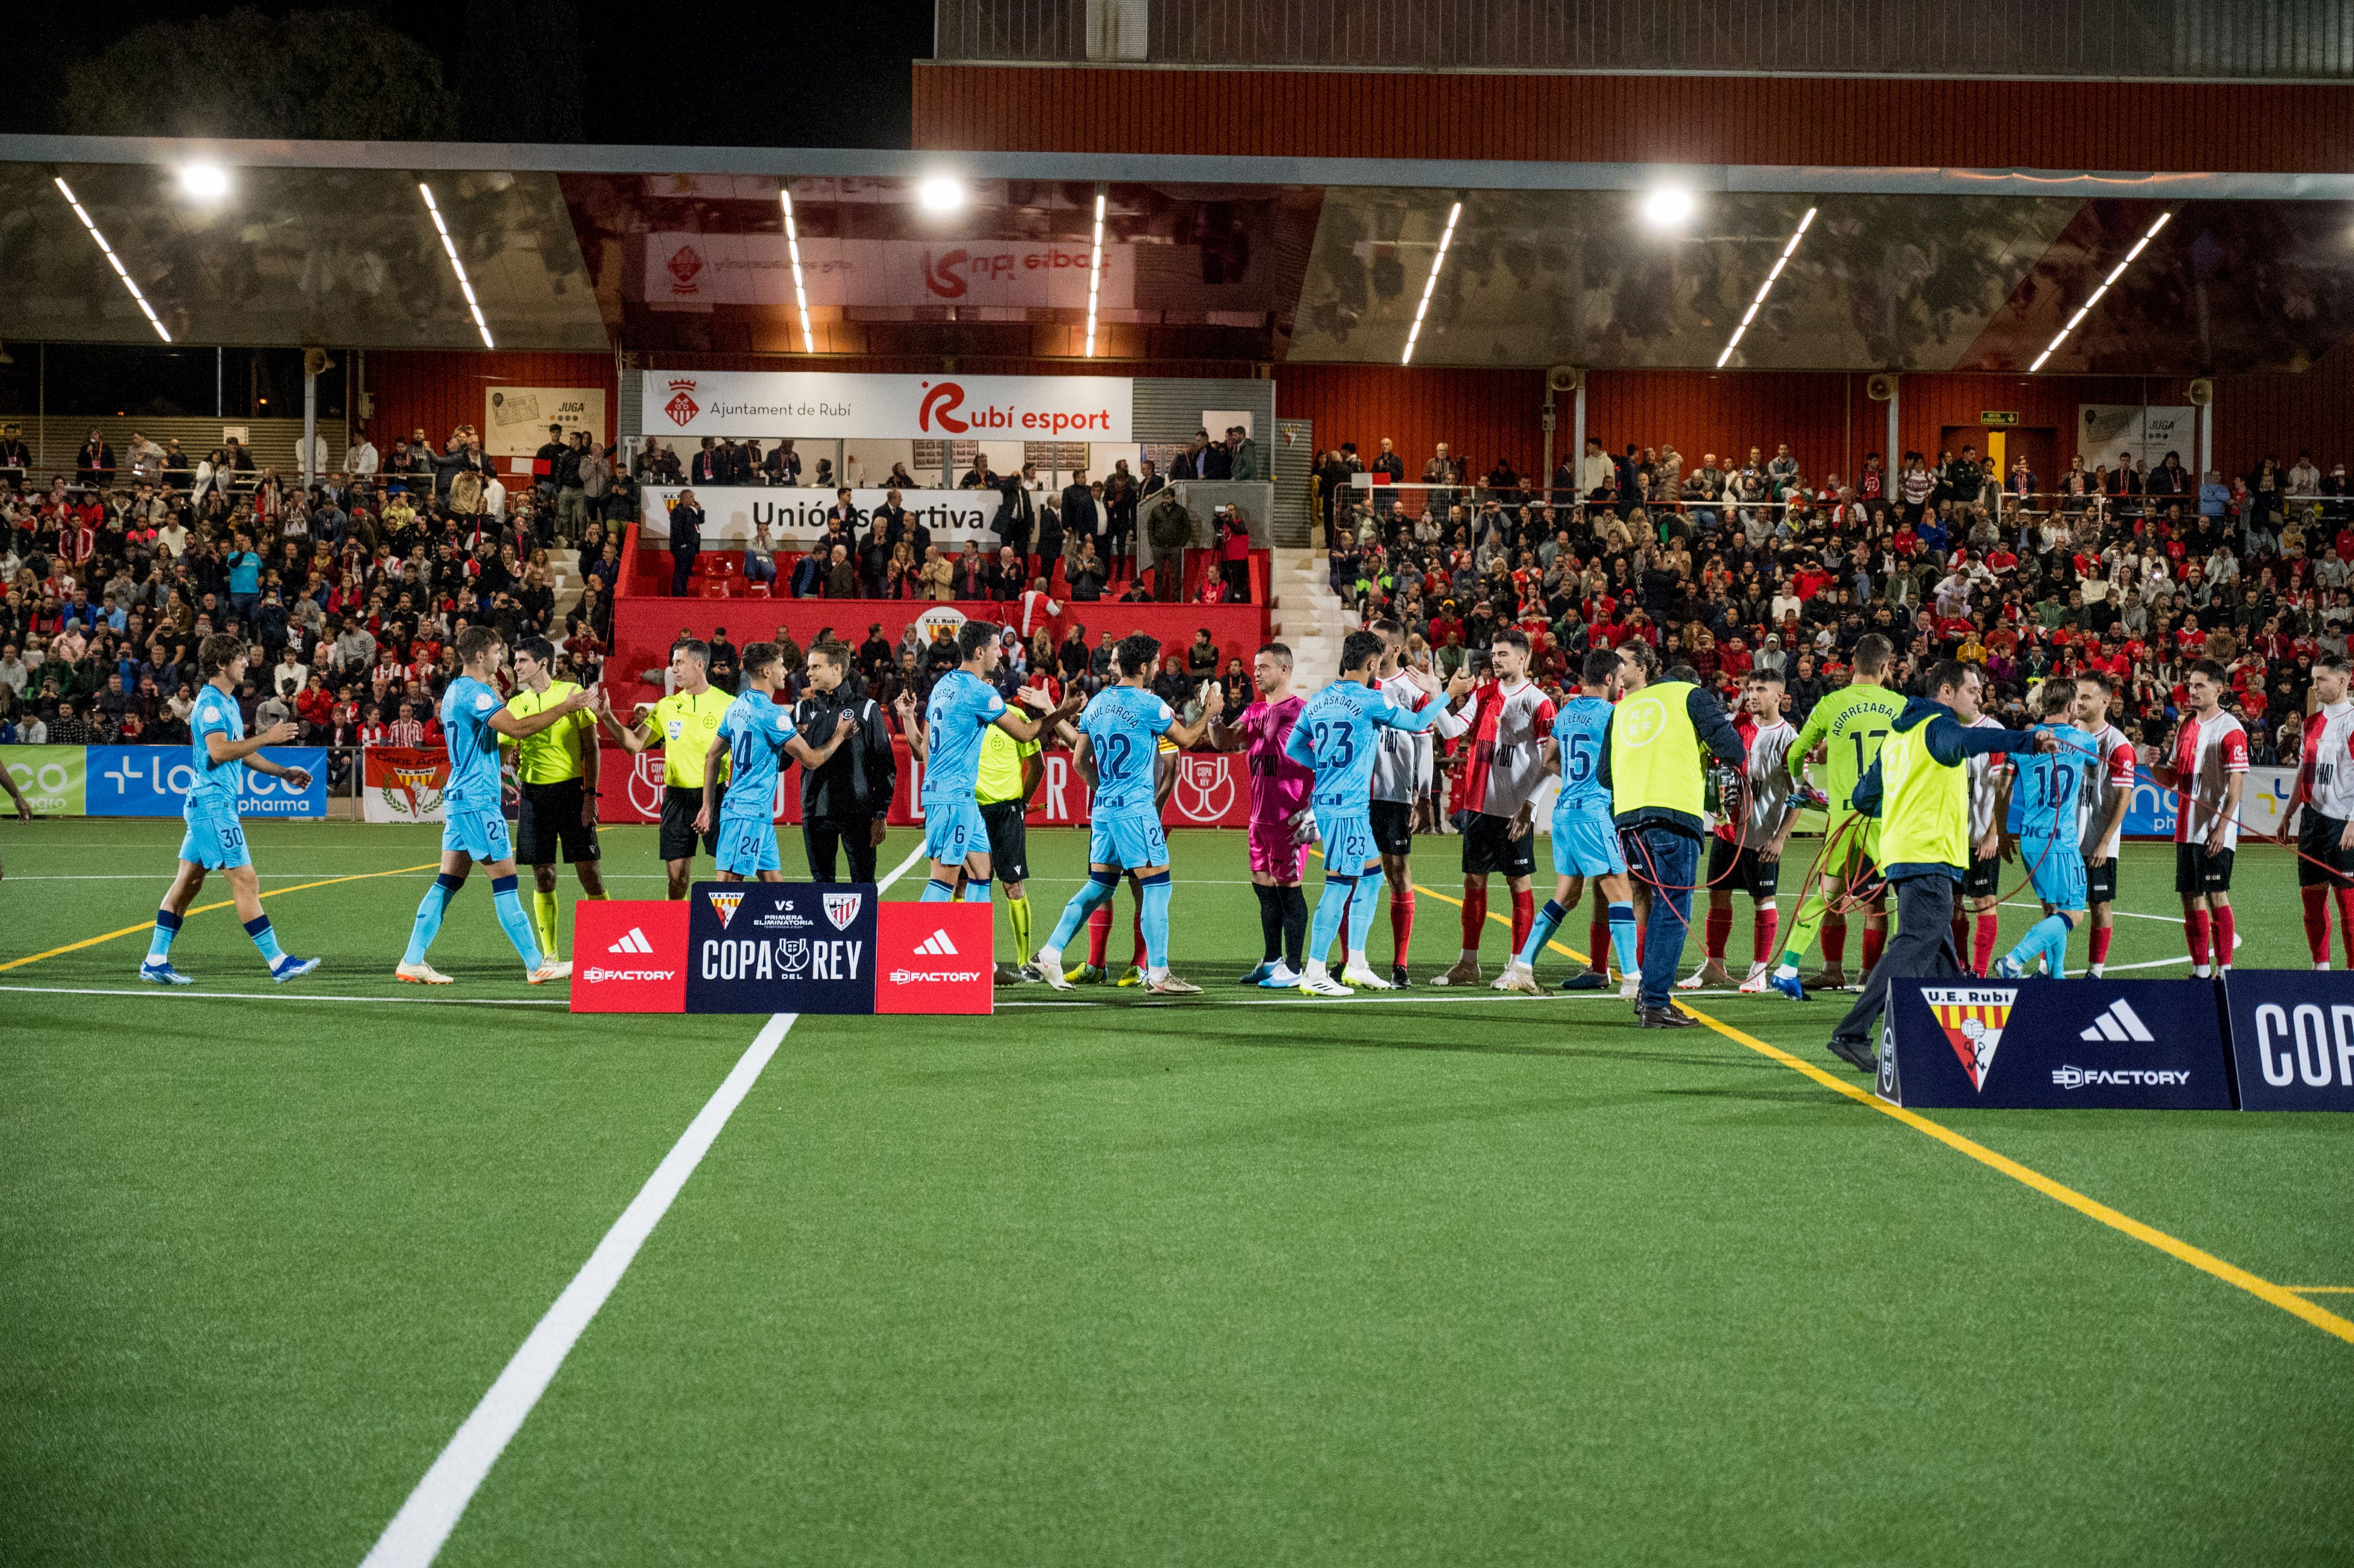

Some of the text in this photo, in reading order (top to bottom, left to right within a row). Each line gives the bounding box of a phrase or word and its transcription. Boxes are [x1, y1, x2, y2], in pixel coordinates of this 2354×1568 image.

[558, 402, 584, 412] JUGA
[710, 402, 851, 419] Ajuntament de Rubí
[919, 381, 1110, 435] Rubí esport
[2149, 420, 2175, 429] JUGA
[935, 688, 955, 701] VESGA
[1308, 695, 1363, 718] NOLASKOAIN
[1563, 713, 1592, 727] I.LEKUE
[1315, 721, 1354, 769] 23
[1094, 733, 1132, 780] 22
[1562, 733, 1592, 782] 15
[2034, 764, 2075, 809] 10
[238, 796, 309, 814] pharma
[220, 827, 243, 848] 30
[487, 819, 506, 840] 27
[954, 825, 965, 844] 6
[740, 836, 760, 857] 24
[1346, 836, 1366, 856] 23
[775, 900, 794, 911] VS
[702, 940, 773, 980] COPA
[813, 940, 862, 980] REY
[1928, 991, 2009, 1002] U.E. Rubí
